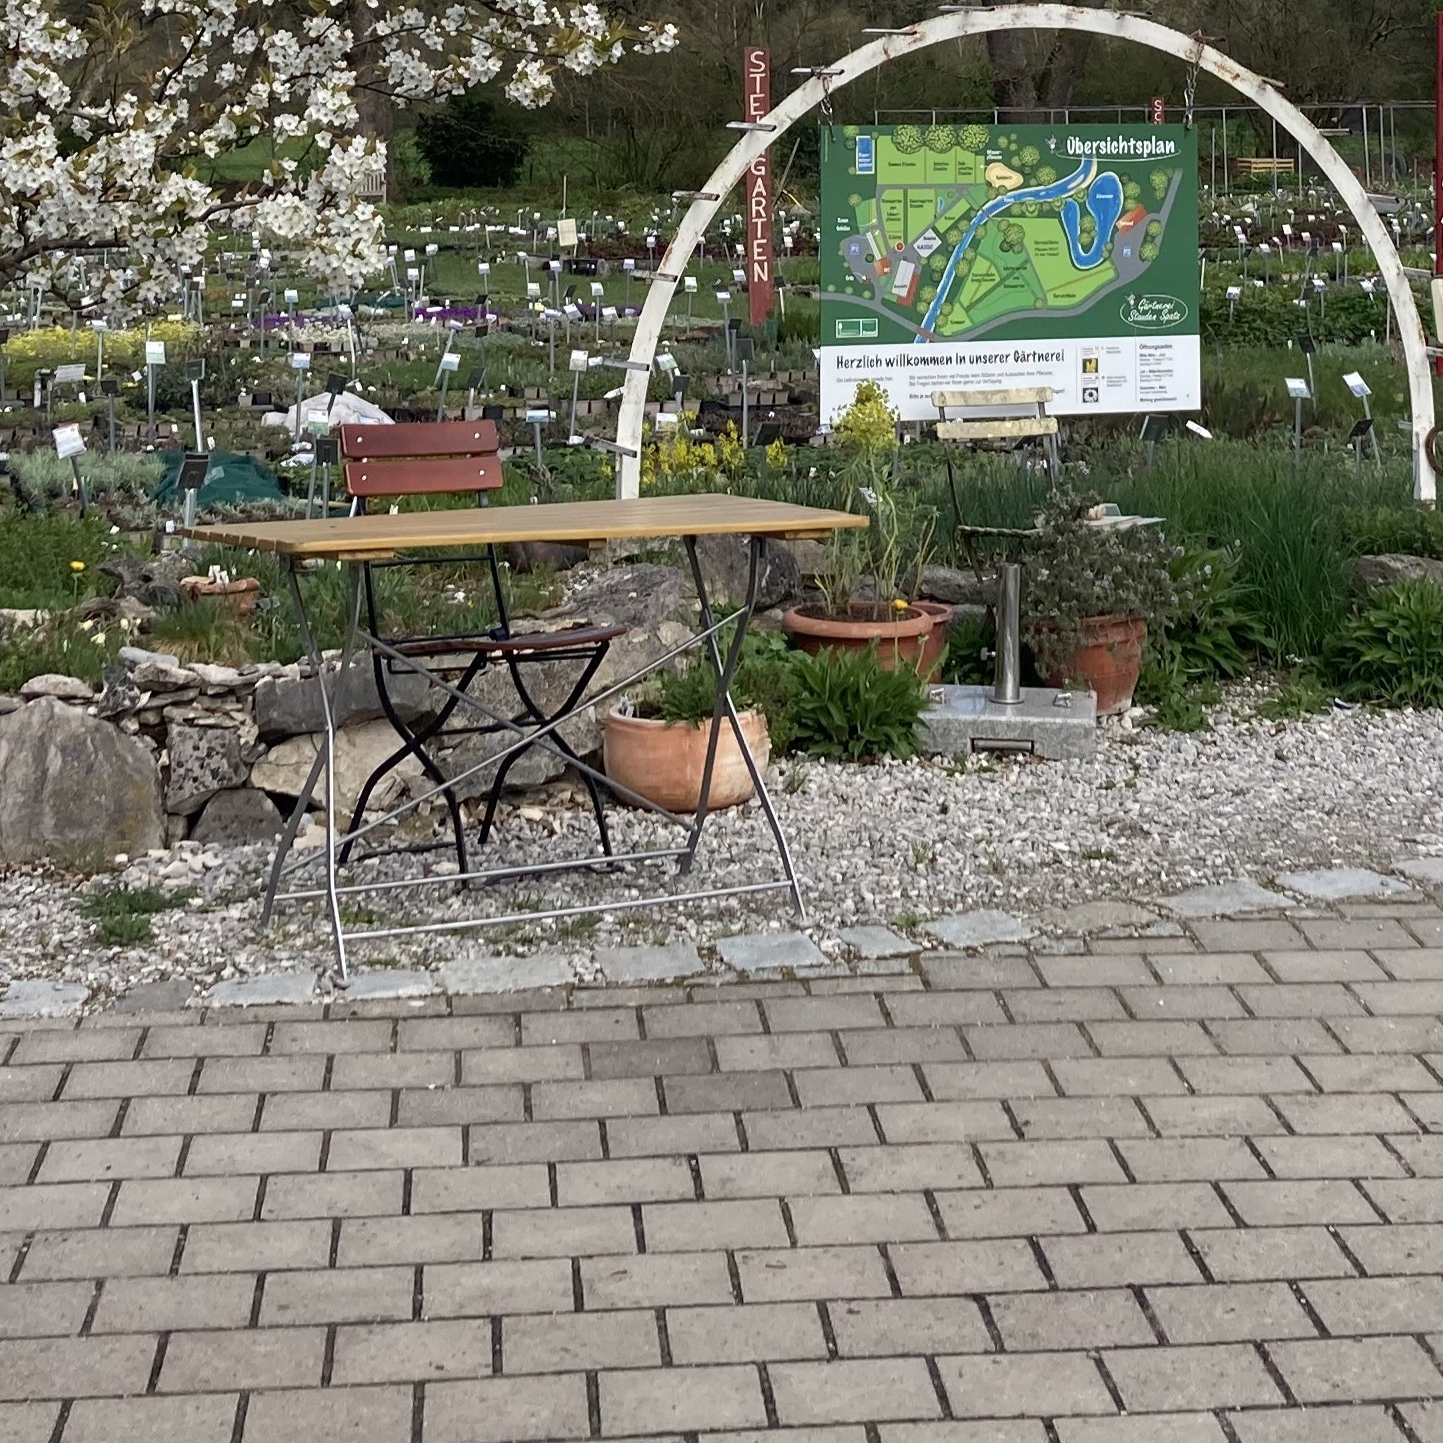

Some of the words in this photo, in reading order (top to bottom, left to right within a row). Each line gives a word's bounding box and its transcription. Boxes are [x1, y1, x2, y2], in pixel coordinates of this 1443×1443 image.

[1066, 134, 1175, 158] Übersichtsplan
[748, 50, 769, 283] STEGARTEN
[836, 354, 882, 369] Herzlich
[885, 353, 953, 368] willkommen
[969, 353, 1011, 365] unserer
[1013, 349, 1065, 363] Gärtnerei
